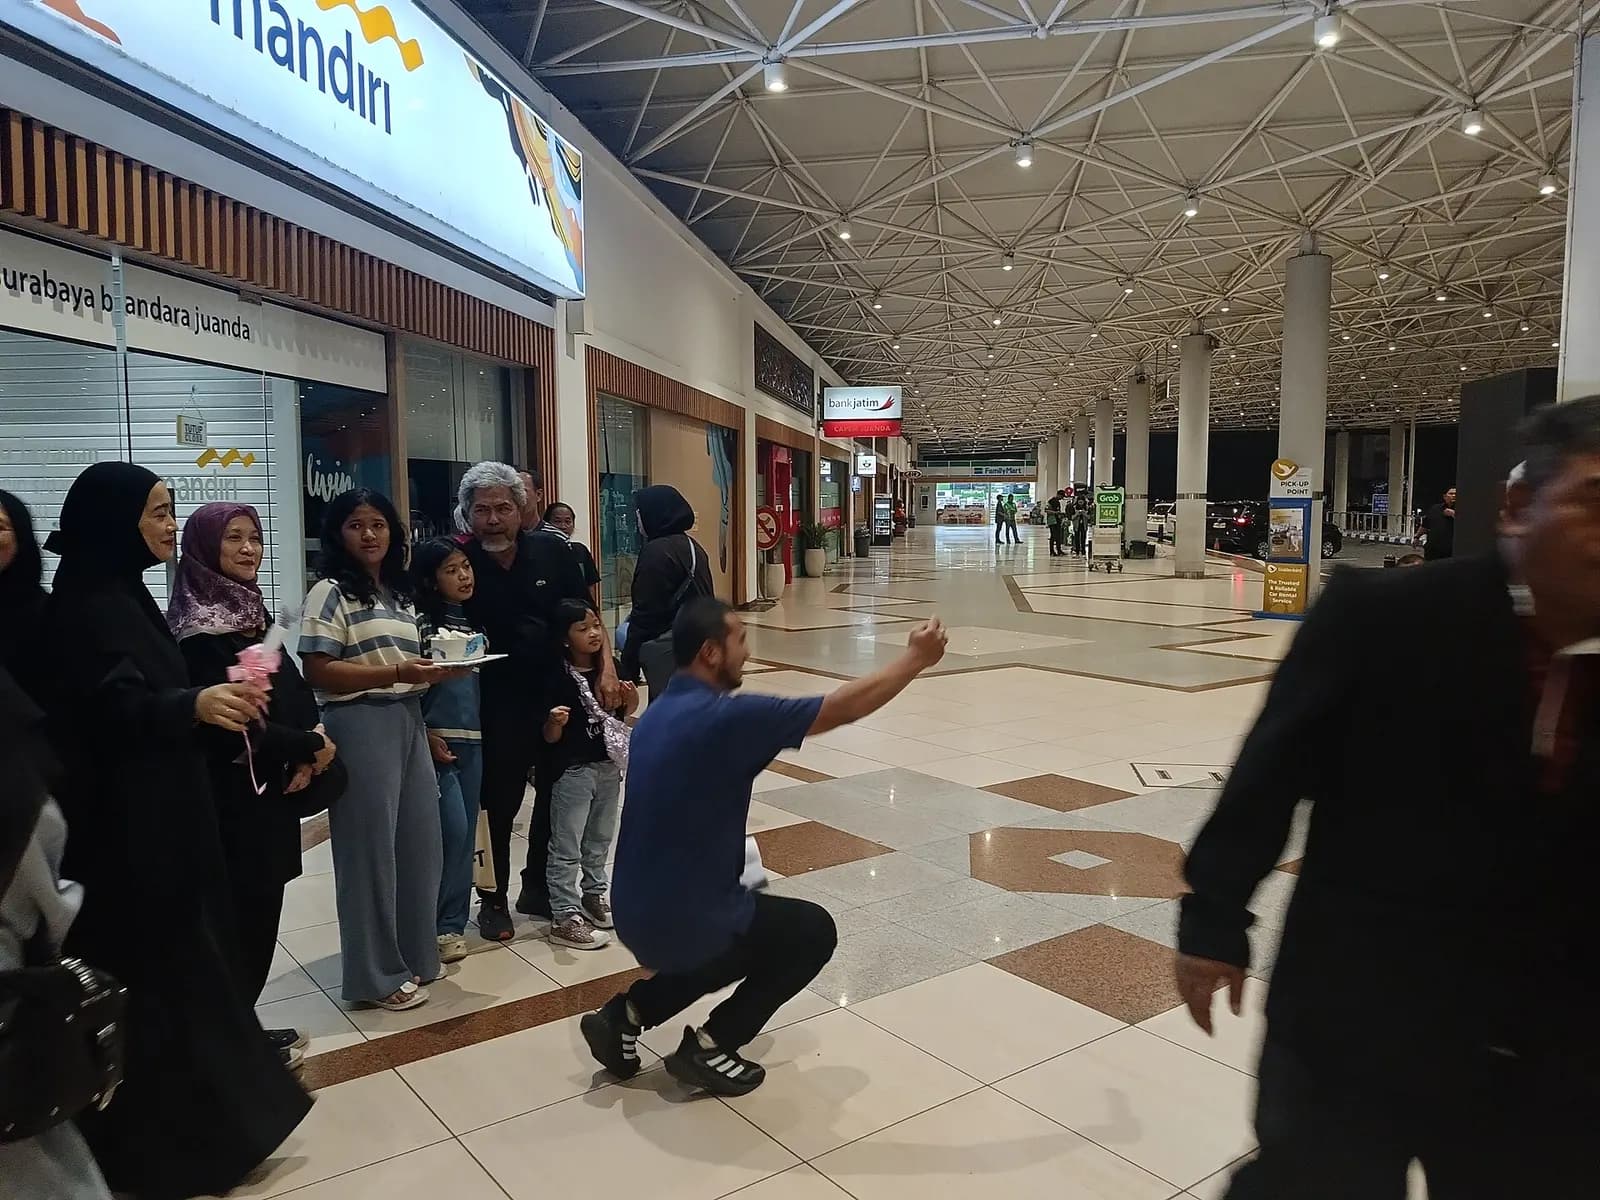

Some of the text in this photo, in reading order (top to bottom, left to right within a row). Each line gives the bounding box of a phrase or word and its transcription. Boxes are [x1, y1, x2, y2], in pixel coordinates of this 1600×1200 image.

[0, 267, 95, 312] urabaya
[195, 306, 250, 341] juanda
[828, 397, 879, 410] bankjatim
[985, 467, 1022, 475] FamilyMart
[164, 469, 238, 501] andiri
[1099, 494, 1120, 502] Grab
